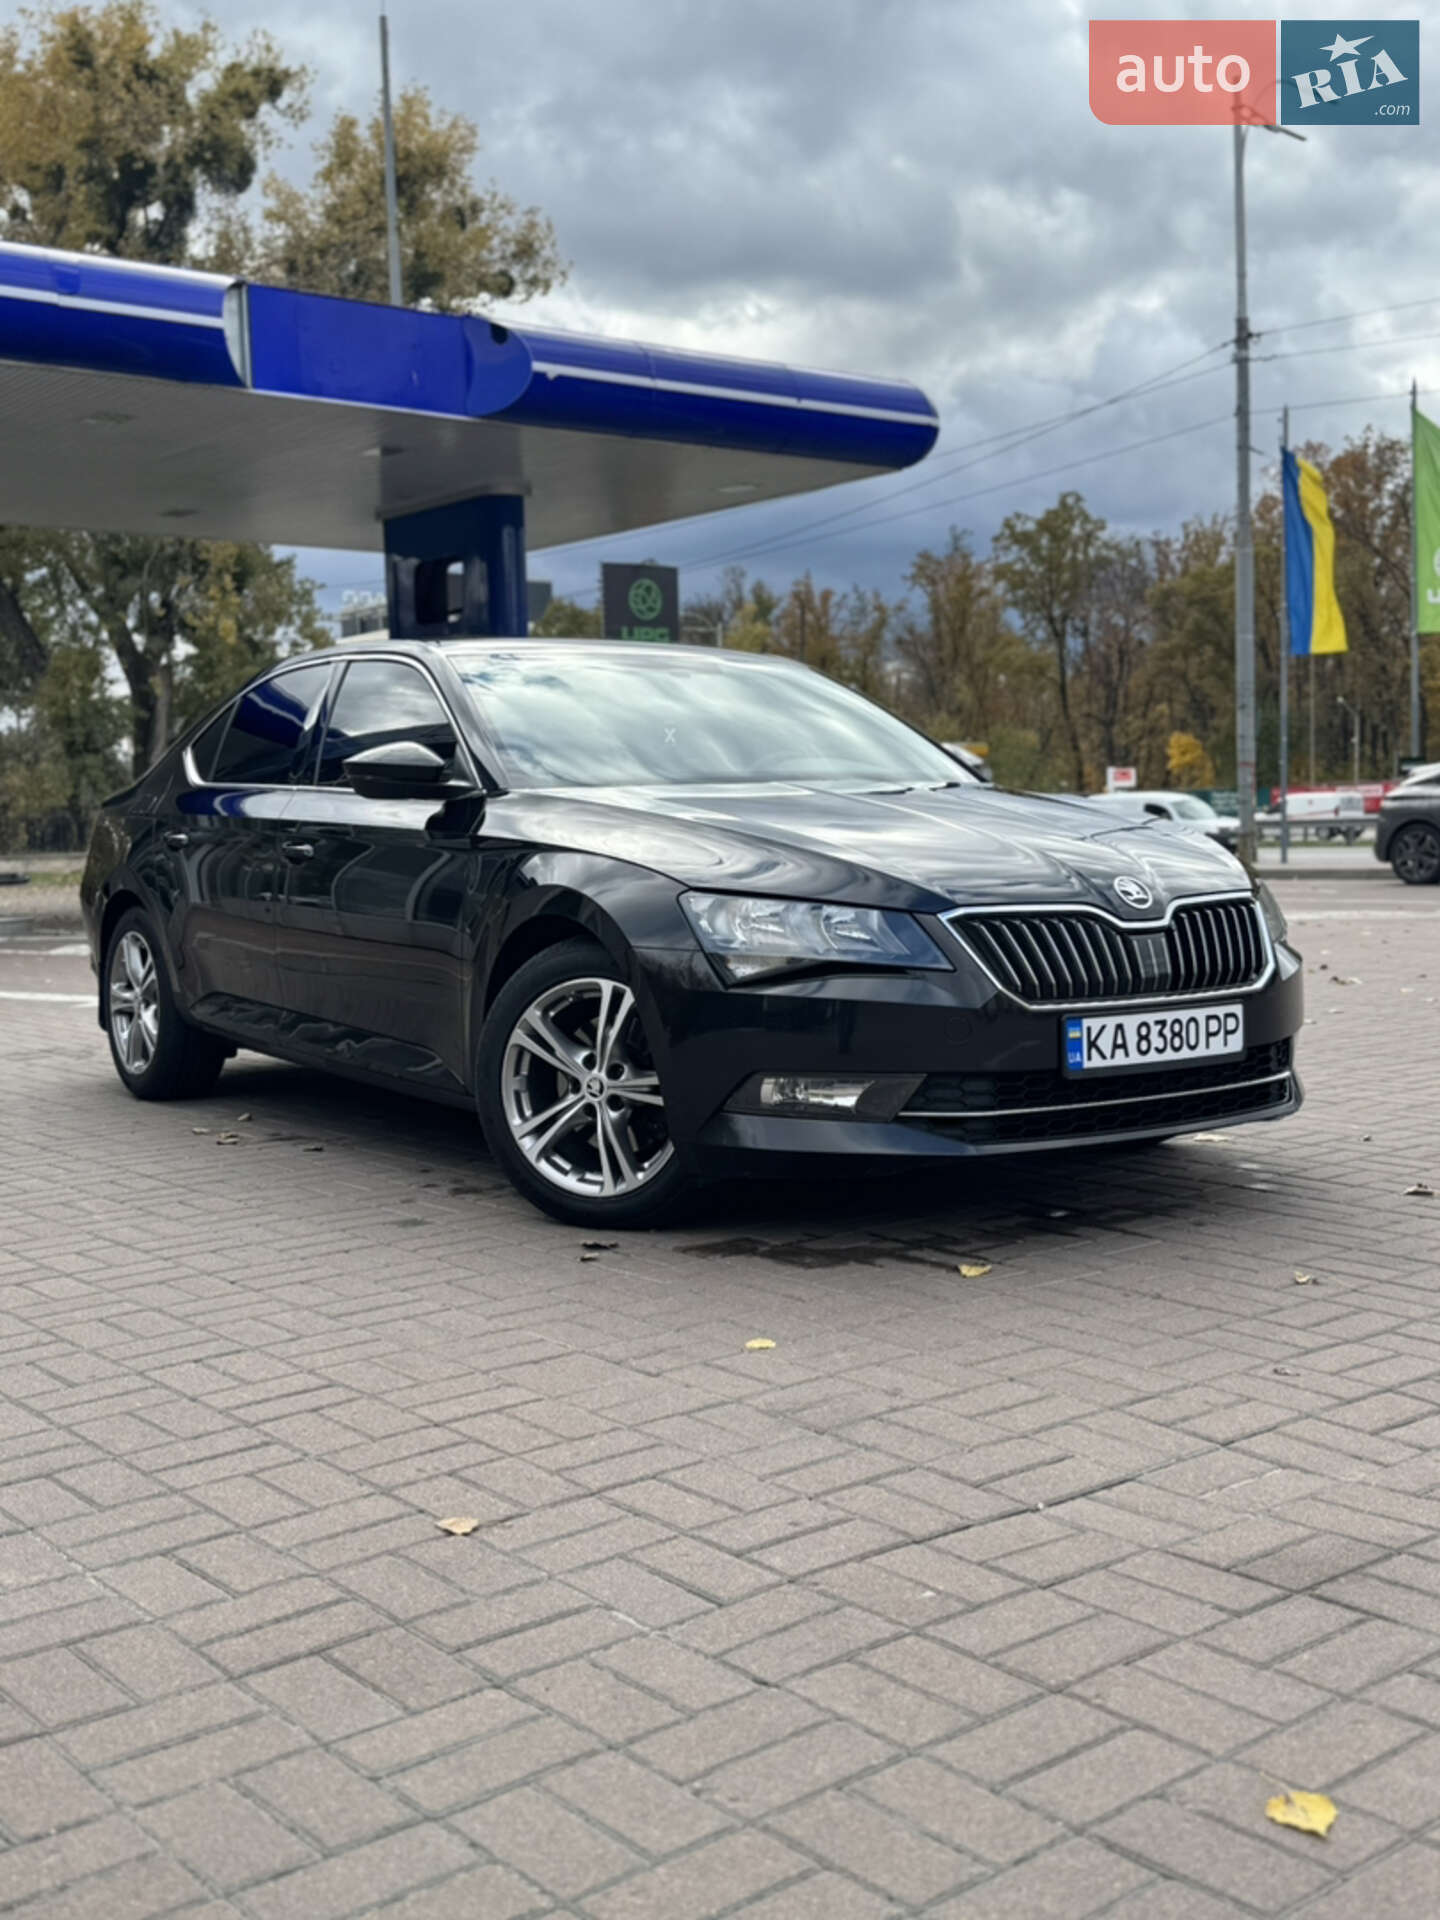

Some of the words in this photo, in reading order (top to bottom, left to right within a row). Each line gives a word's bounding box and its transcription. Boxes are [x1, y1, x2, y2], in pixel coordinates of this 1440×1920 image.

[1086, 1023, 1130, 1062] KA
[1136, 1016, 1200, 1057] 8380
[1205, 1012, 1240, 1050] PP
[1068, 1051, 1082, 1063] UA
